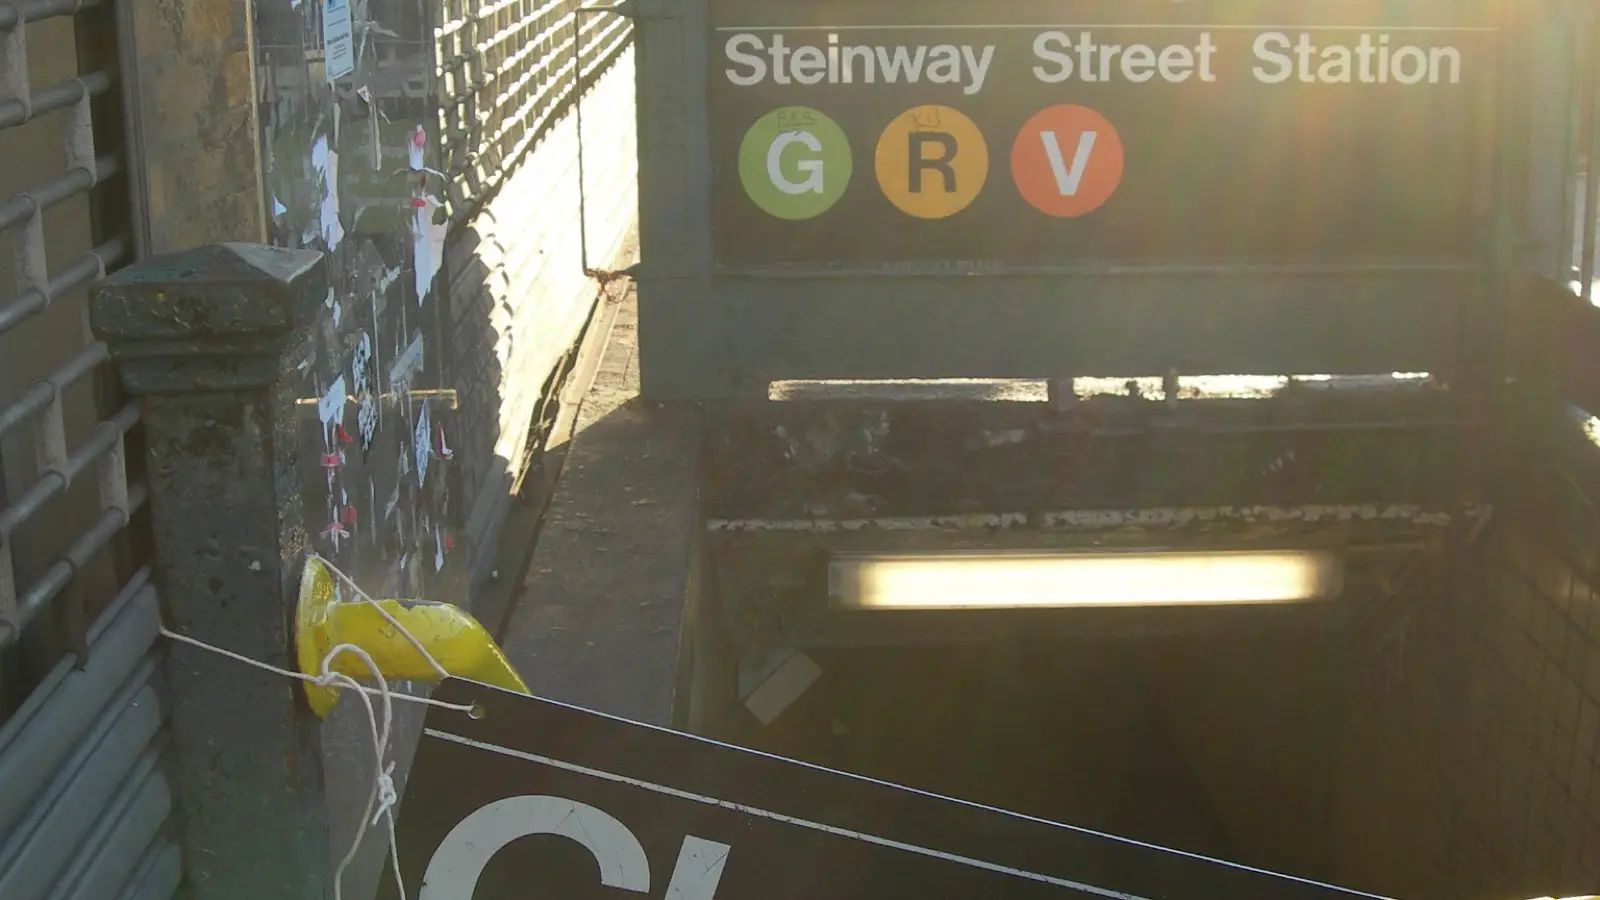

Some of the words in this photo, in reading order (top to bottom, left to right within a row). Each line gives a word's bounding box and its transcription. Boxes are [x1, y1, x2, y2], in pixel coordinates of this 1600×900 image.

[724, 33, 995, 95] Steinway
[1031, 31, 1217, 83] Street
[1251, 31, 1461, 84] Station
[766, 131, 824, 195] G
[907, 131, 958, 193] R
[1039, 131, 1098, 196] V
